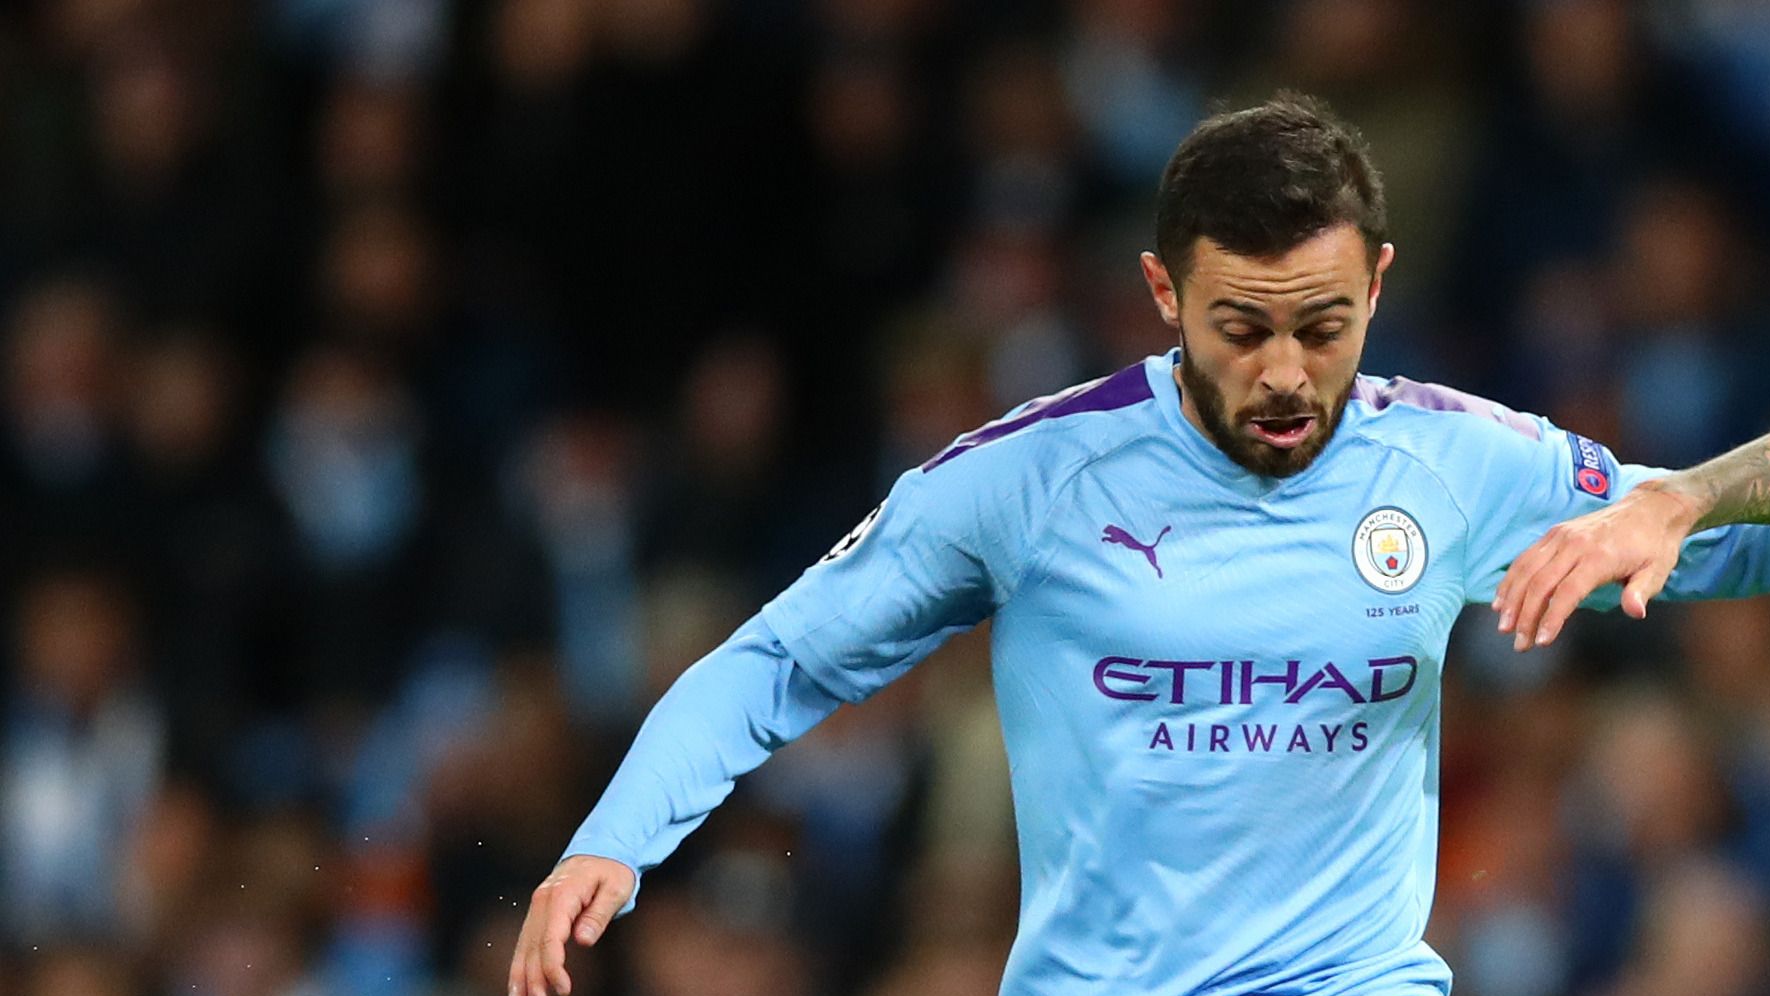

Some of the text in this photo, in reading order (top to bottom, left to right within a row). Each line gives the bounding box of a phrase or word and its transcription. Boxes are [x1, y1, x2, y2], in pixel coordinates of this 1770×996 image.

[1359, 512, 1417, 540] MANCHESTER
[1382, 579, 1405, 588] CITY
[1365, 604, 1420, 618] 125 YEARS
[1093, 655, 1418, 705] ETIHAD
[1149, 721, 1369, 753] AIRWAYS
